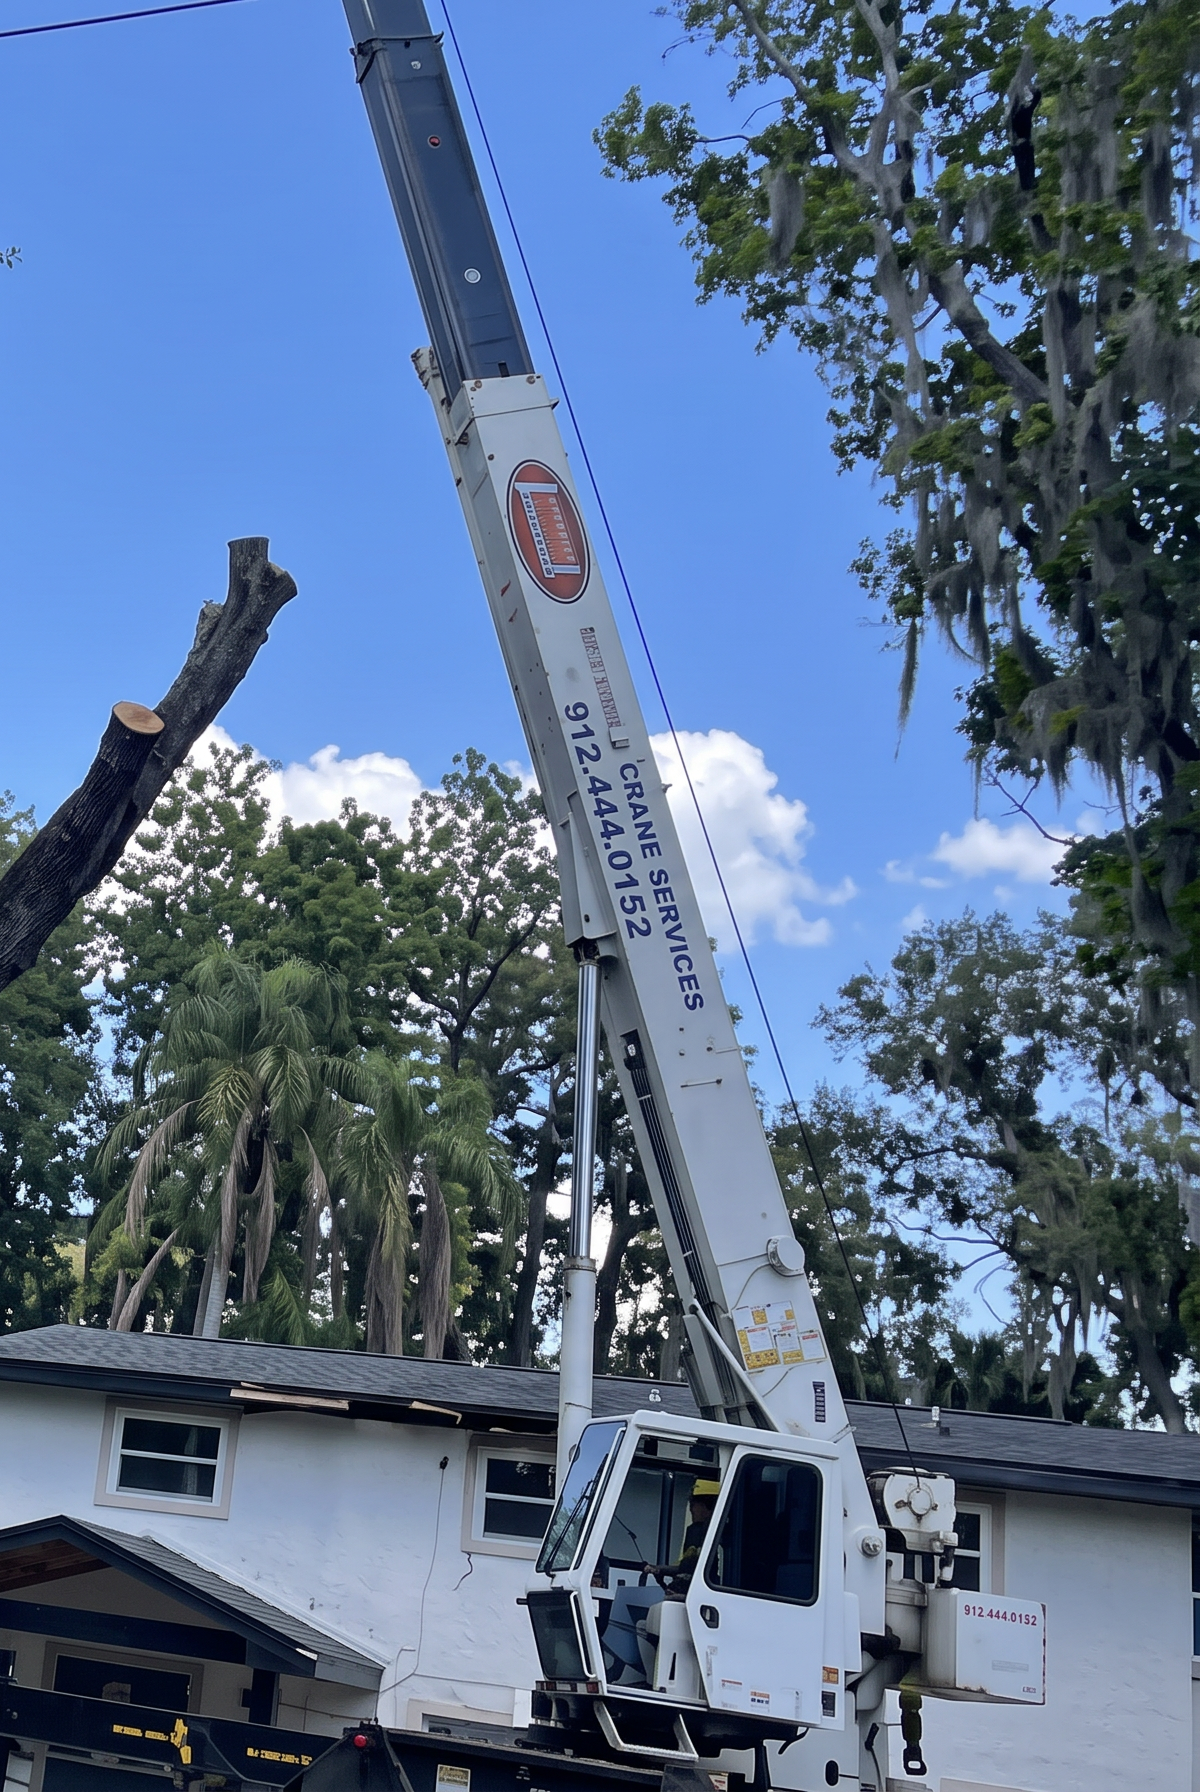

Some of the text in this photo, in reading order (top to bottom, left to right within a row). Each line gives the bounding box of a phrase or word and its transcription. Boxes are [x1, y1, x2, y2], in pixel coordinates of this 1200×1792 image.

[564, 701, 652, 940] 912.444.0152
[619, 762, 704, 1011] CRANE SERVICES
